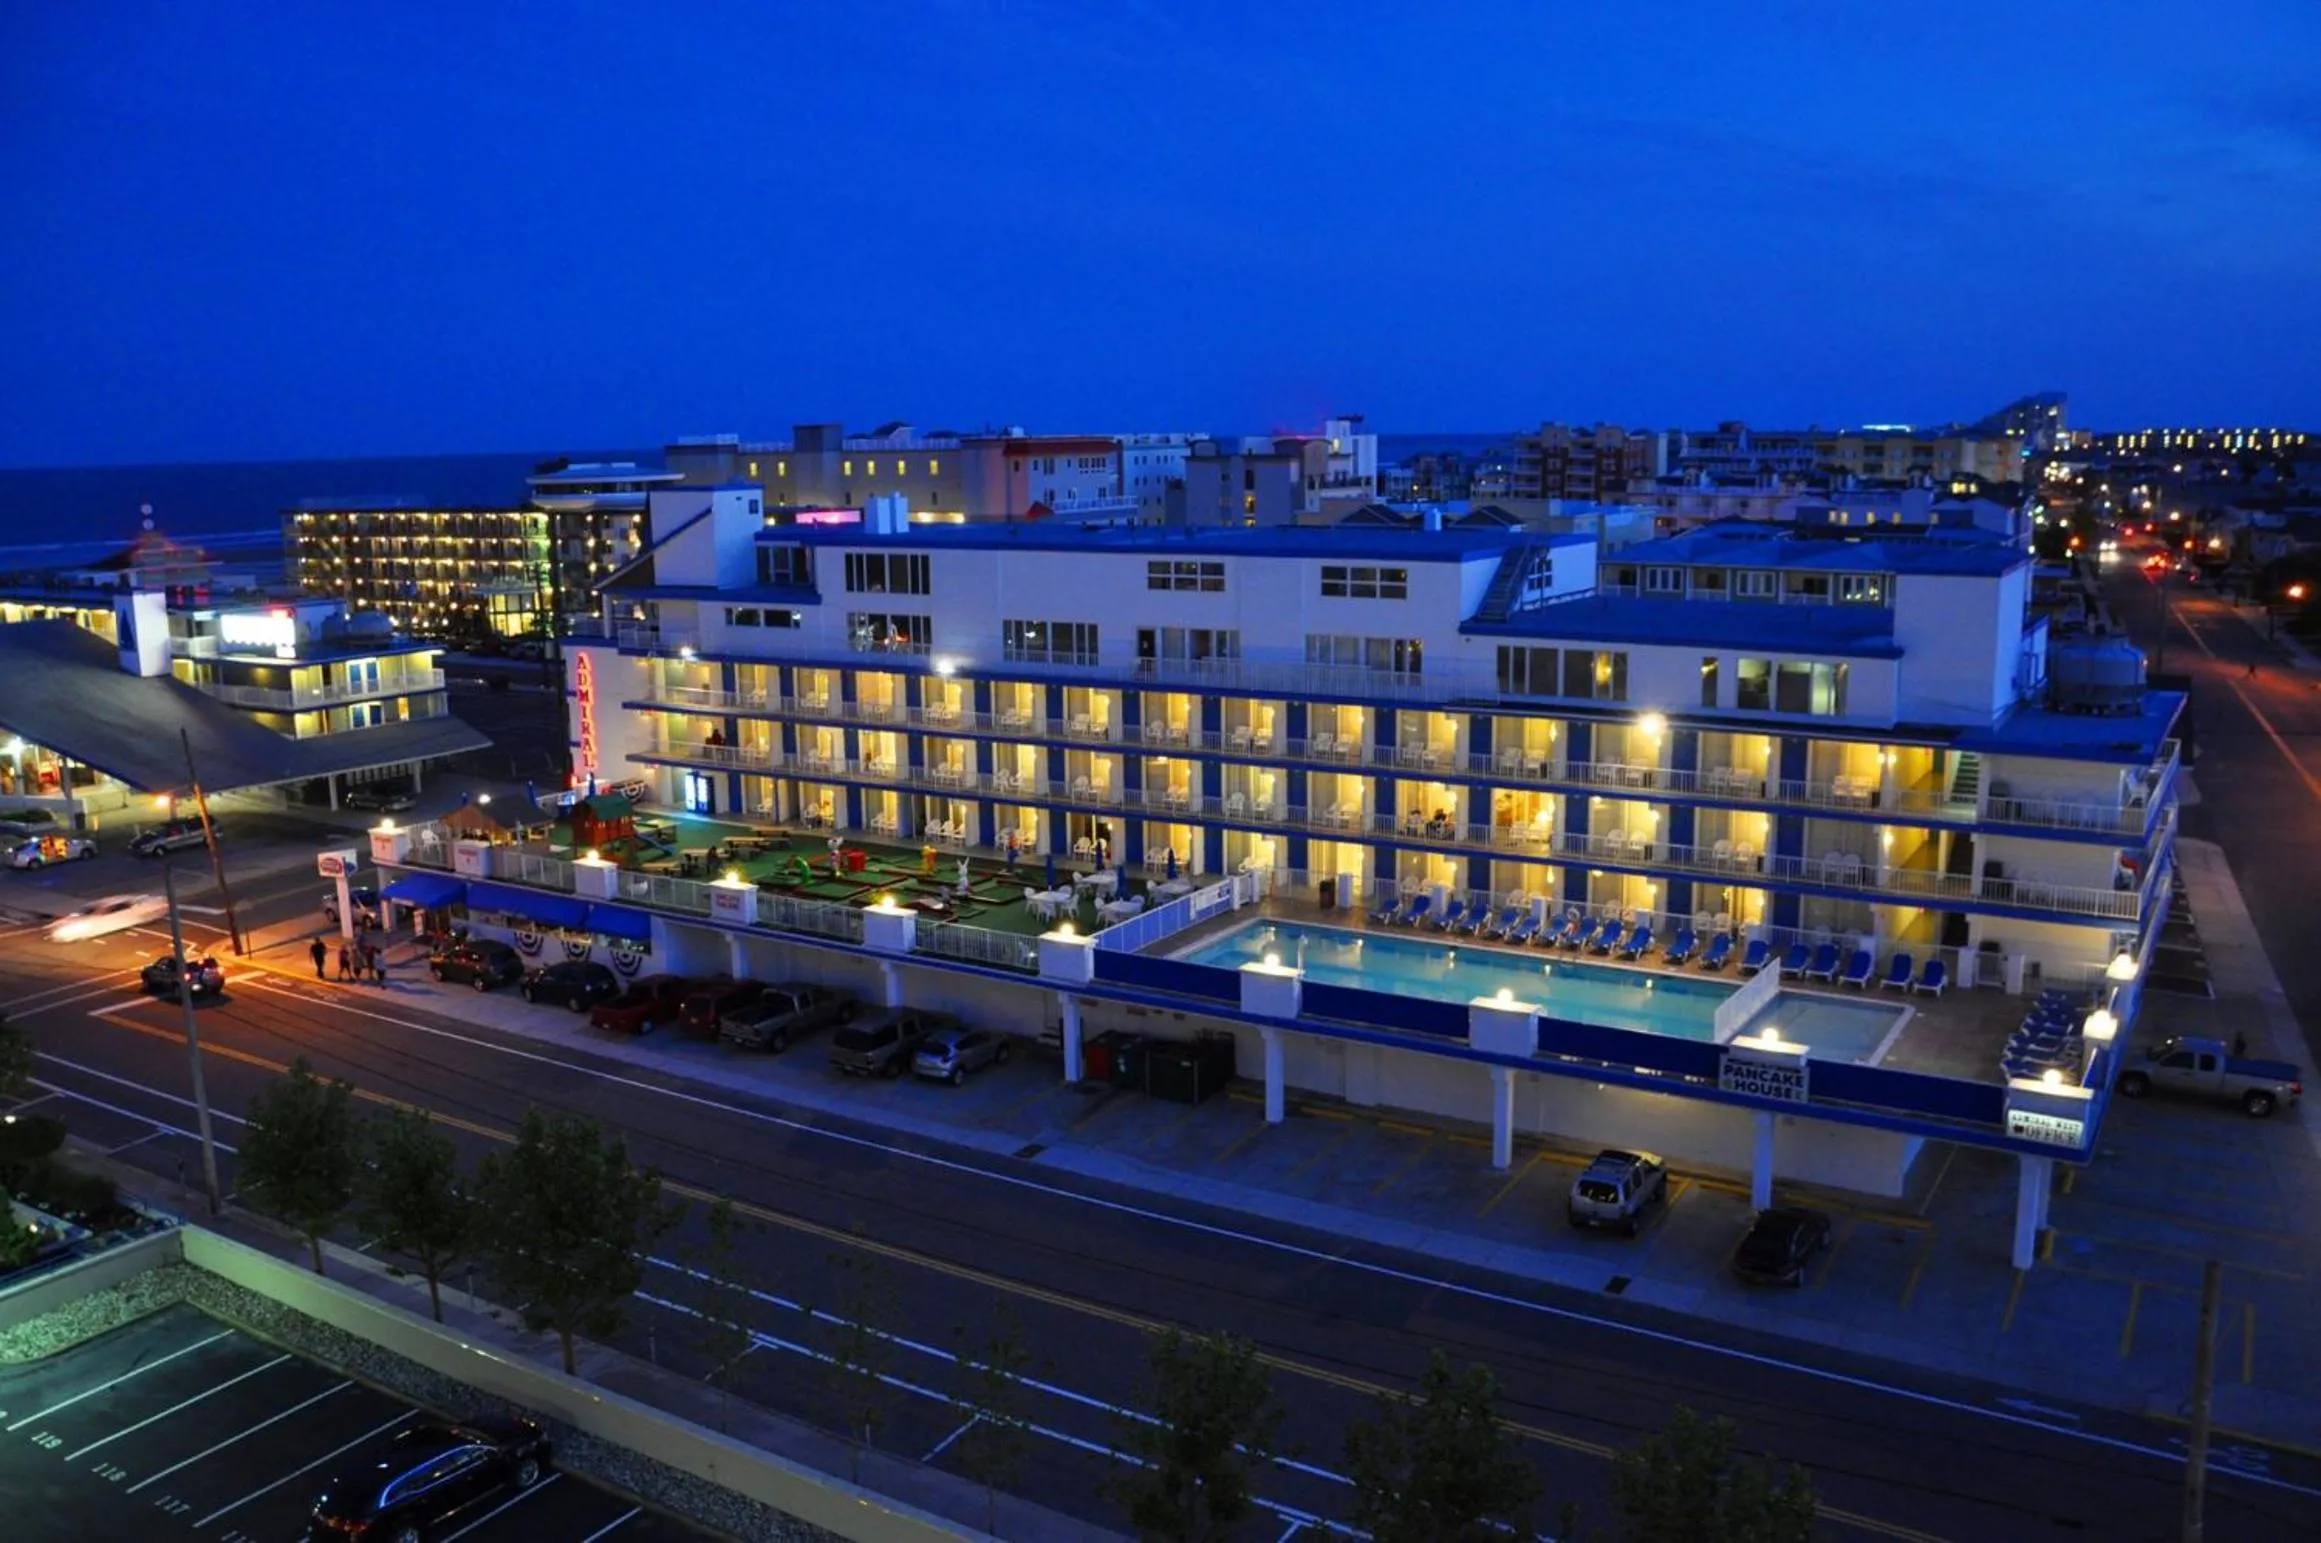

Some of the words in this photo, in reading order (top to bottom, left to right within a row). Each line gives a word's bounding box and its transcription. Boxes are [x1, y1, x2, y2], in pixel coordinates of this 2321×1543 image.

[576, 653, 597, 769] ADMIRAL
[1723, 1064, 1805, 1089] PANCAKE
[1734, 1080, 1793, 1099] HOUSE
[2026, 1124, 2081, 1147] OFFICE
[31, 1431, 63, 1449] 119
[92, 1462, 127, 1482] 118
[154, 1495, 191, 1514] 117
